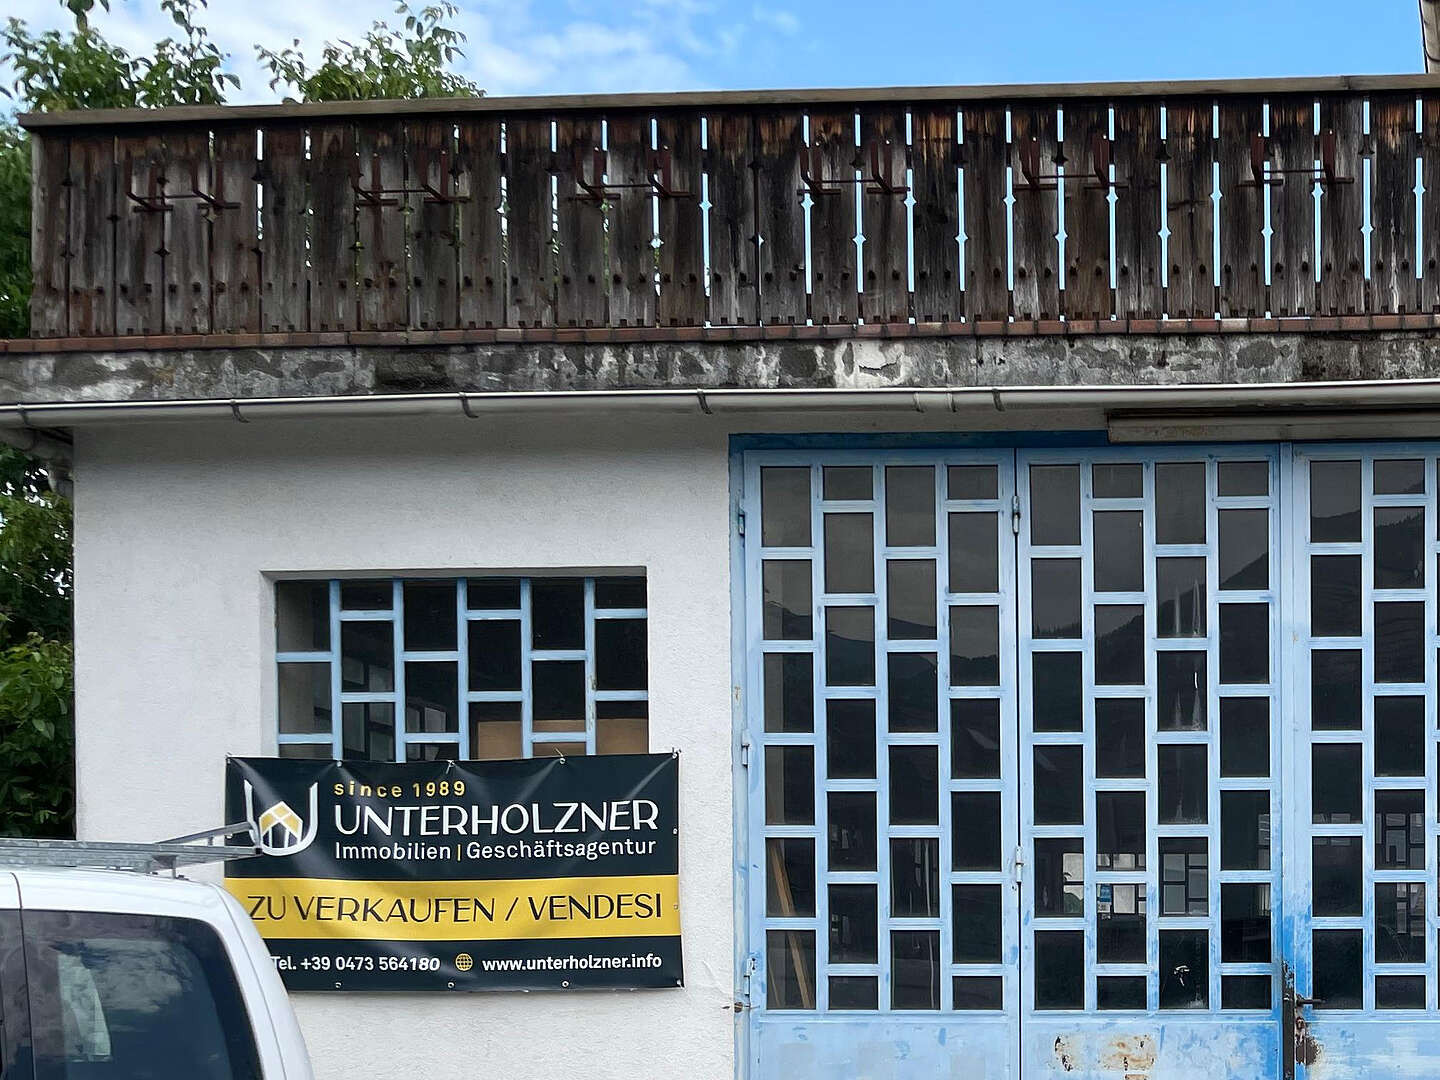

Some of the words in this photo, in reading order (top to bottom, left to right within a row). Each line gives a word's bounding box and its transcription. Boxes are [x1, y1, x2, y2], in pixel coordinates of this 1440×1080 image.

[334, 781, 402, 797] since
[413, 782, 465, 798] 1989
[335, 800, 658, 836] UNTERHOLZNER
[335, 842, 451, 860] Immobilien
[467, 839, 656, 860] Geschäftsagentur
[248, 896, 286, 921] ZU
[294, 896, 495, 922] VERKAUFEN
[528, 893, 661, 921] VENDESI
[271, 956, 297, 970] Tel.
[301, 957, 330, 970] +39
[335, 957, 373, 970] 0473
[379, 957, 440, 970] 564180
[482, 954, 662, 970] www.unterholzner.info
